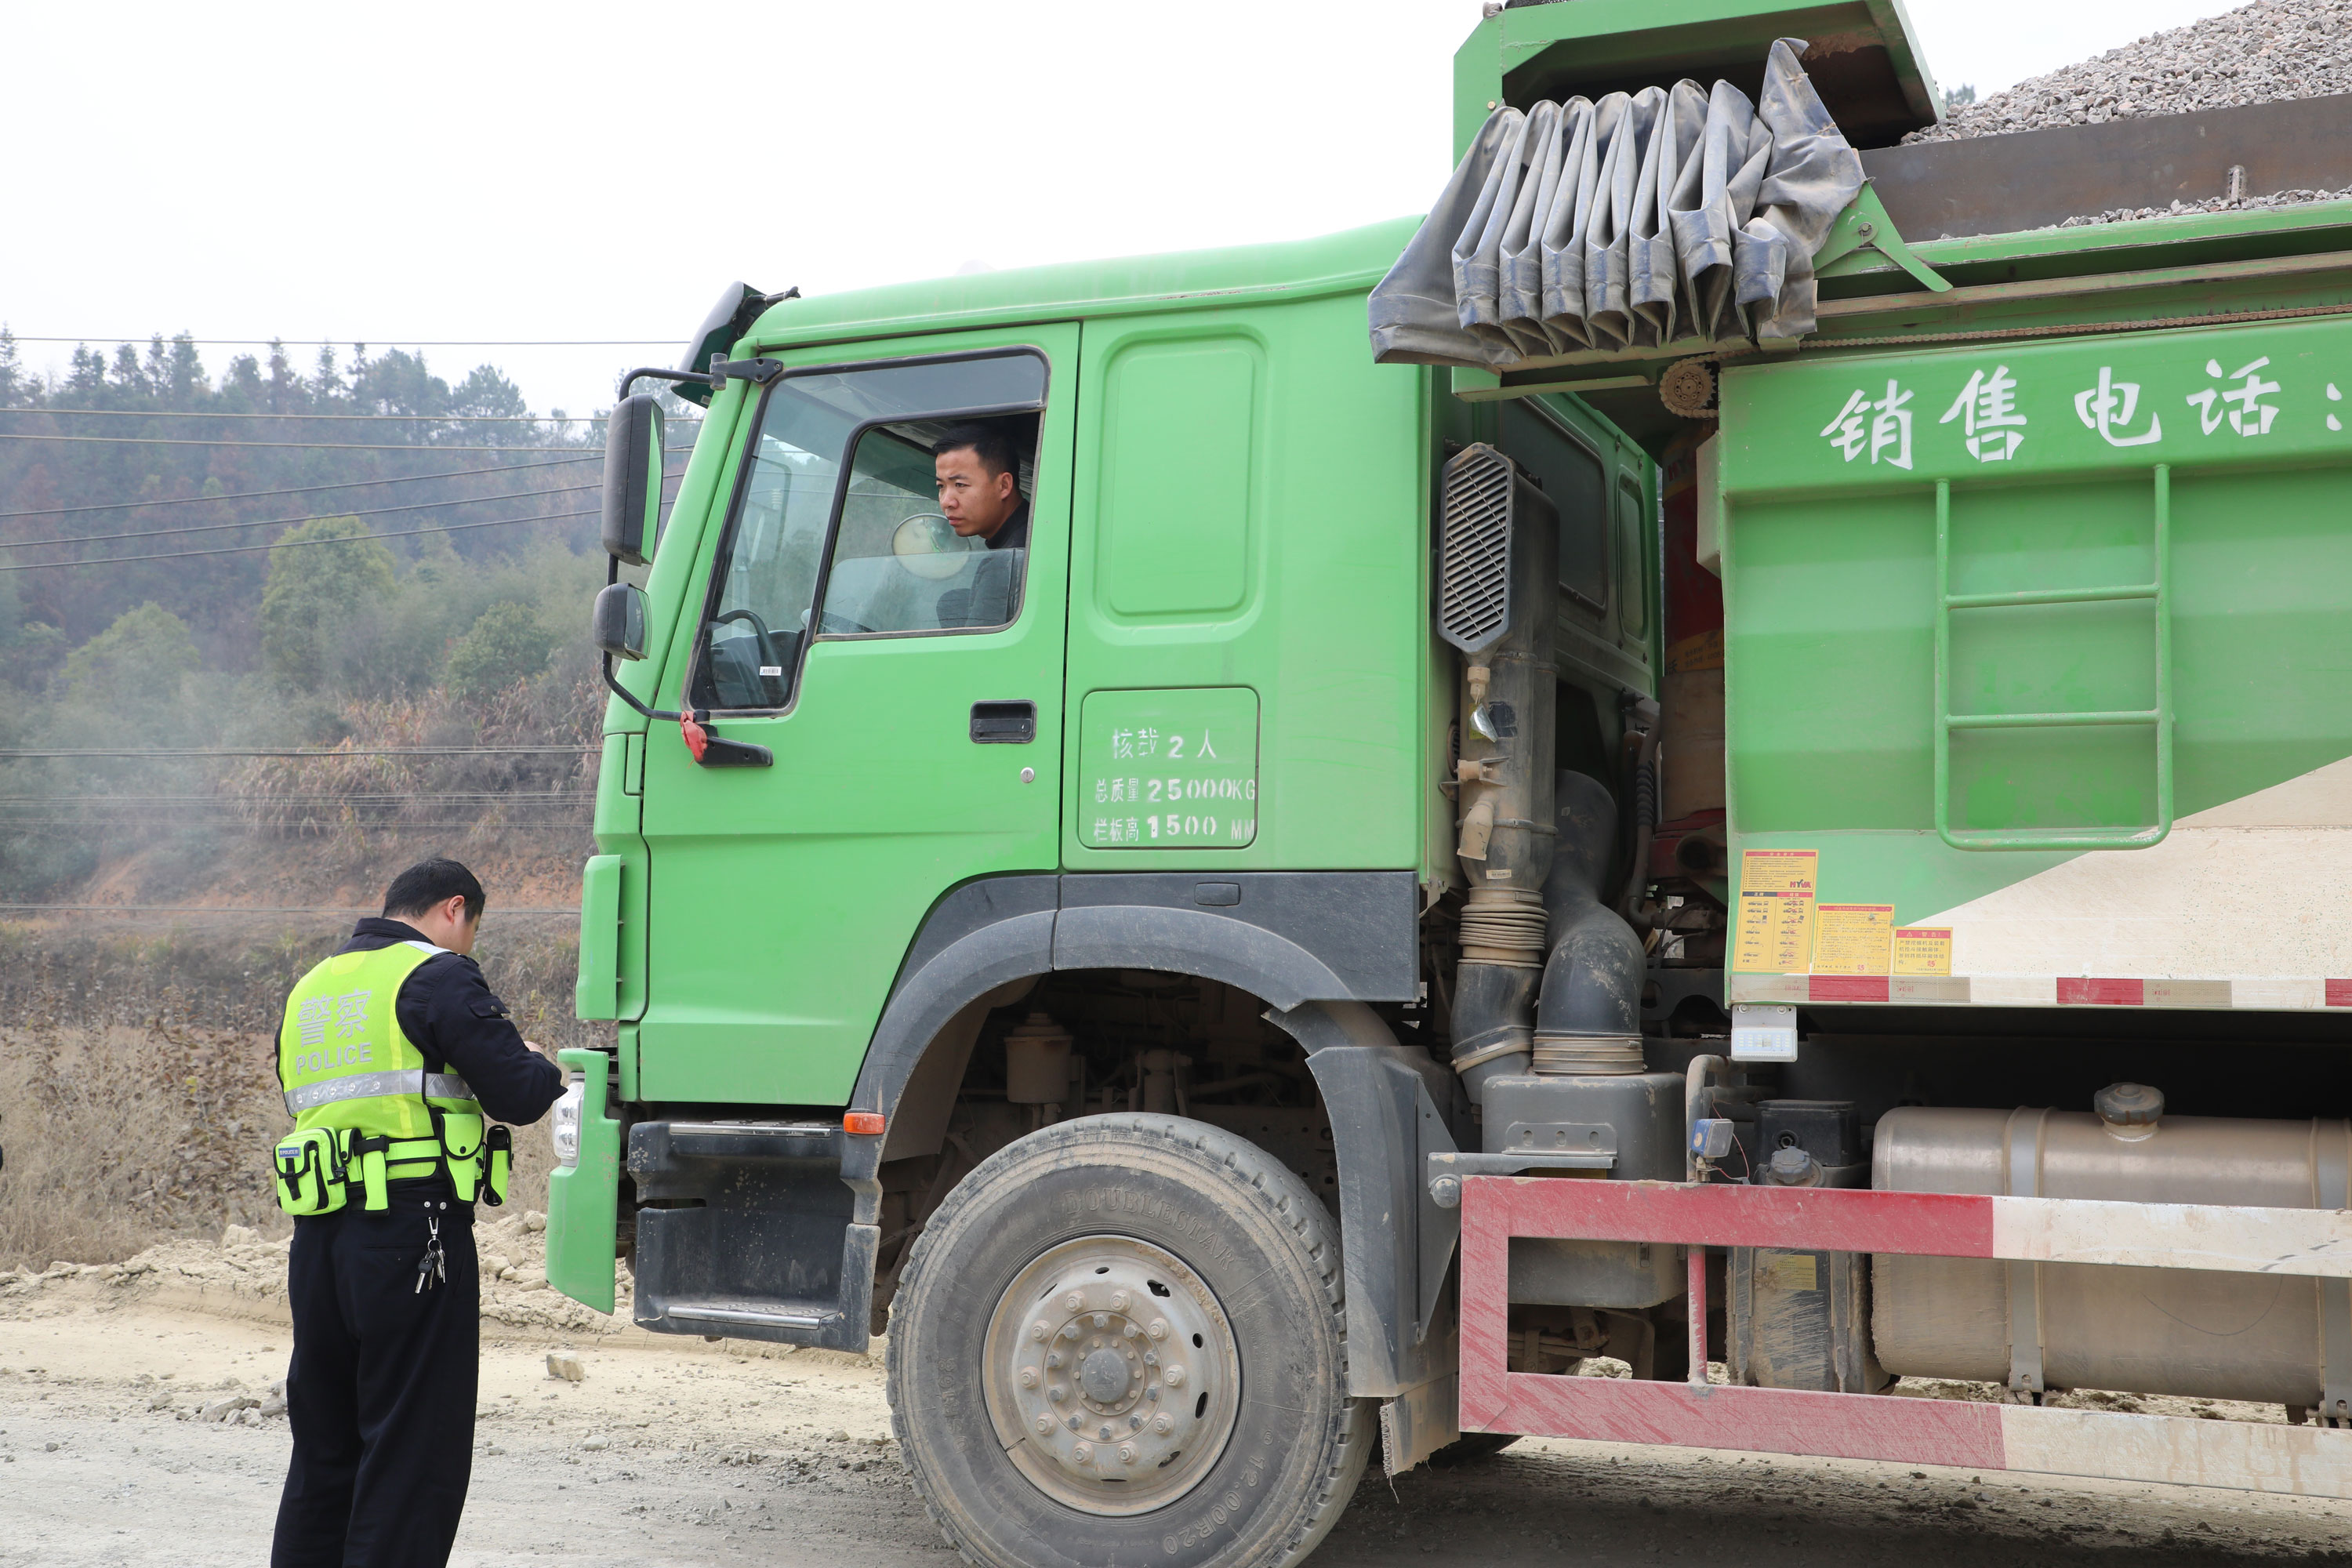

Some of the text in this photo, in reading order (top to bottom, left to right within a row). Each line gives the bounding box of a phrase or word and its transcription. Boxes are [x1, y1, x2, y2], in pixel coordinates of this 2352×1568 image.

[1789, 879, 1812, 888] HYVA
[296, 987, 372, 1048] 警察
[296, 1042, 373, 1076] POLICE
[1063, 1187, 1237, 1272] DOUBLESTAR
[1163, 1455, 1267, 1555] 12.00R20
